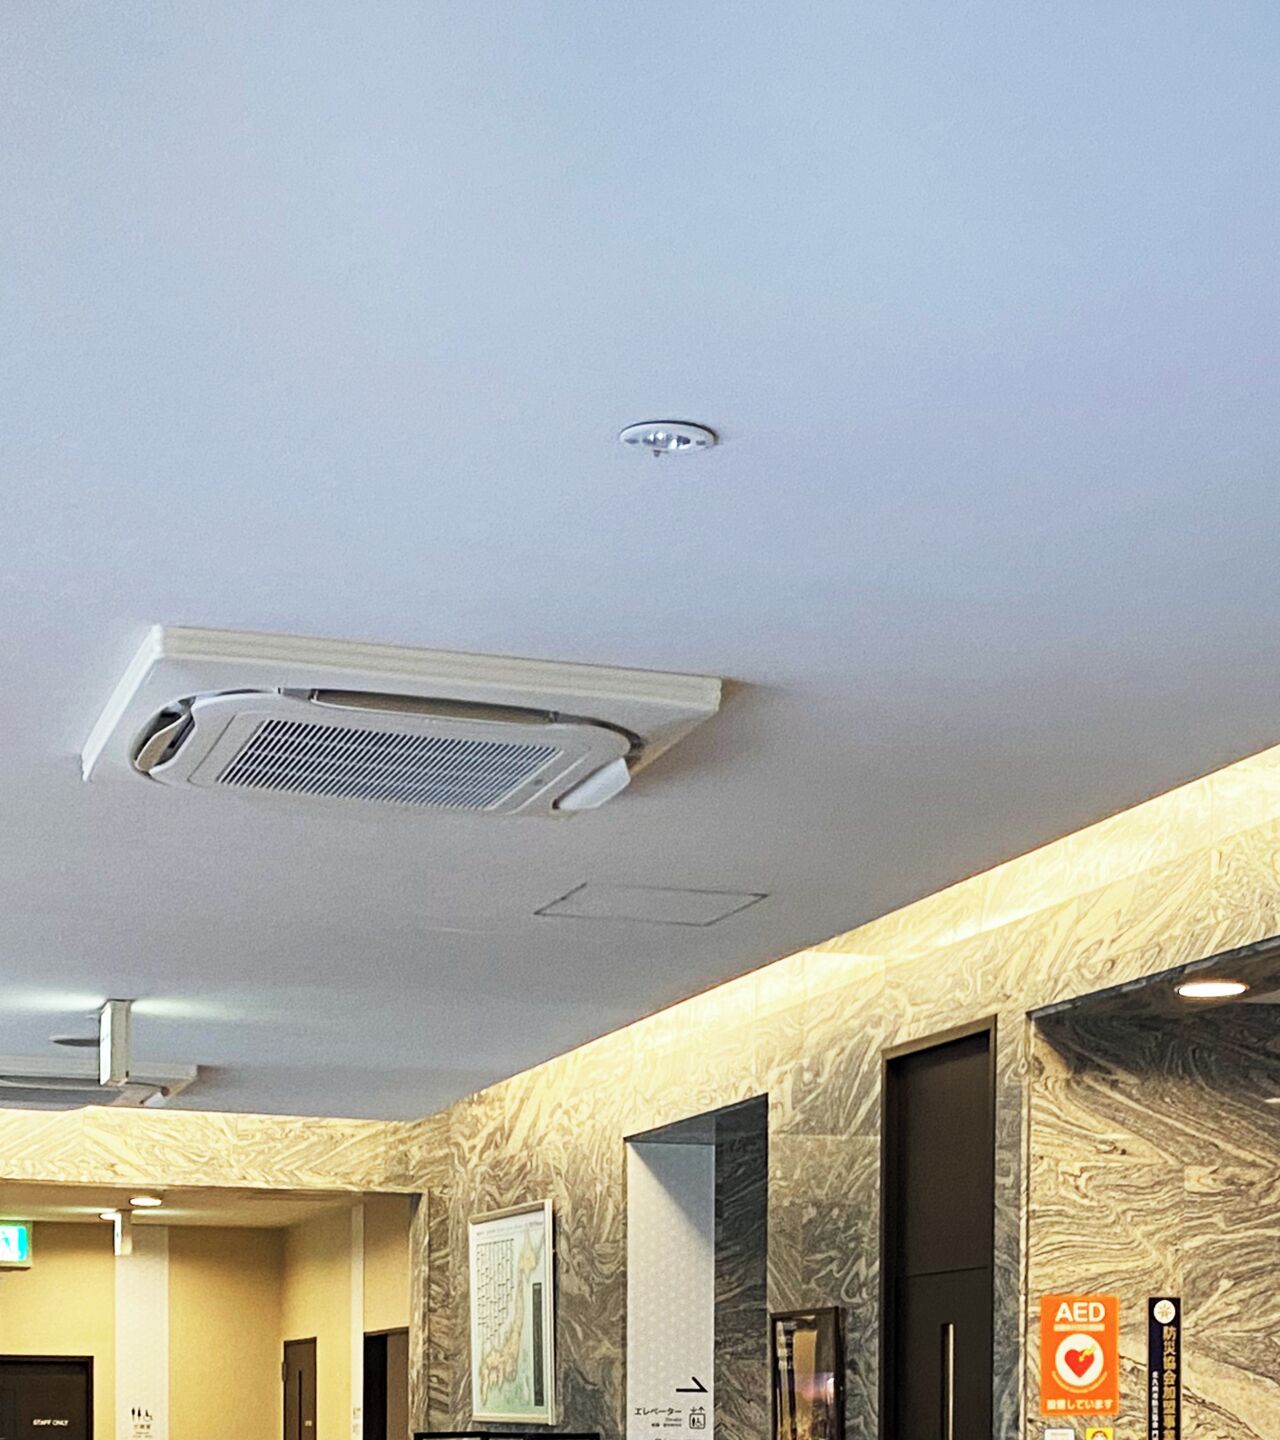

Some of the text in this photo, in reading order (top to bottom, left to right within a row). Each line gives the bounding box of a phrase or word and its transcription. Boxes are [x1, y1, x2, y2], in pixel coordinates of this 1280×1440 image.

[1055, 1302, 1105, 1322] AED
[634, 1407, 682, 1416] エレベーター
